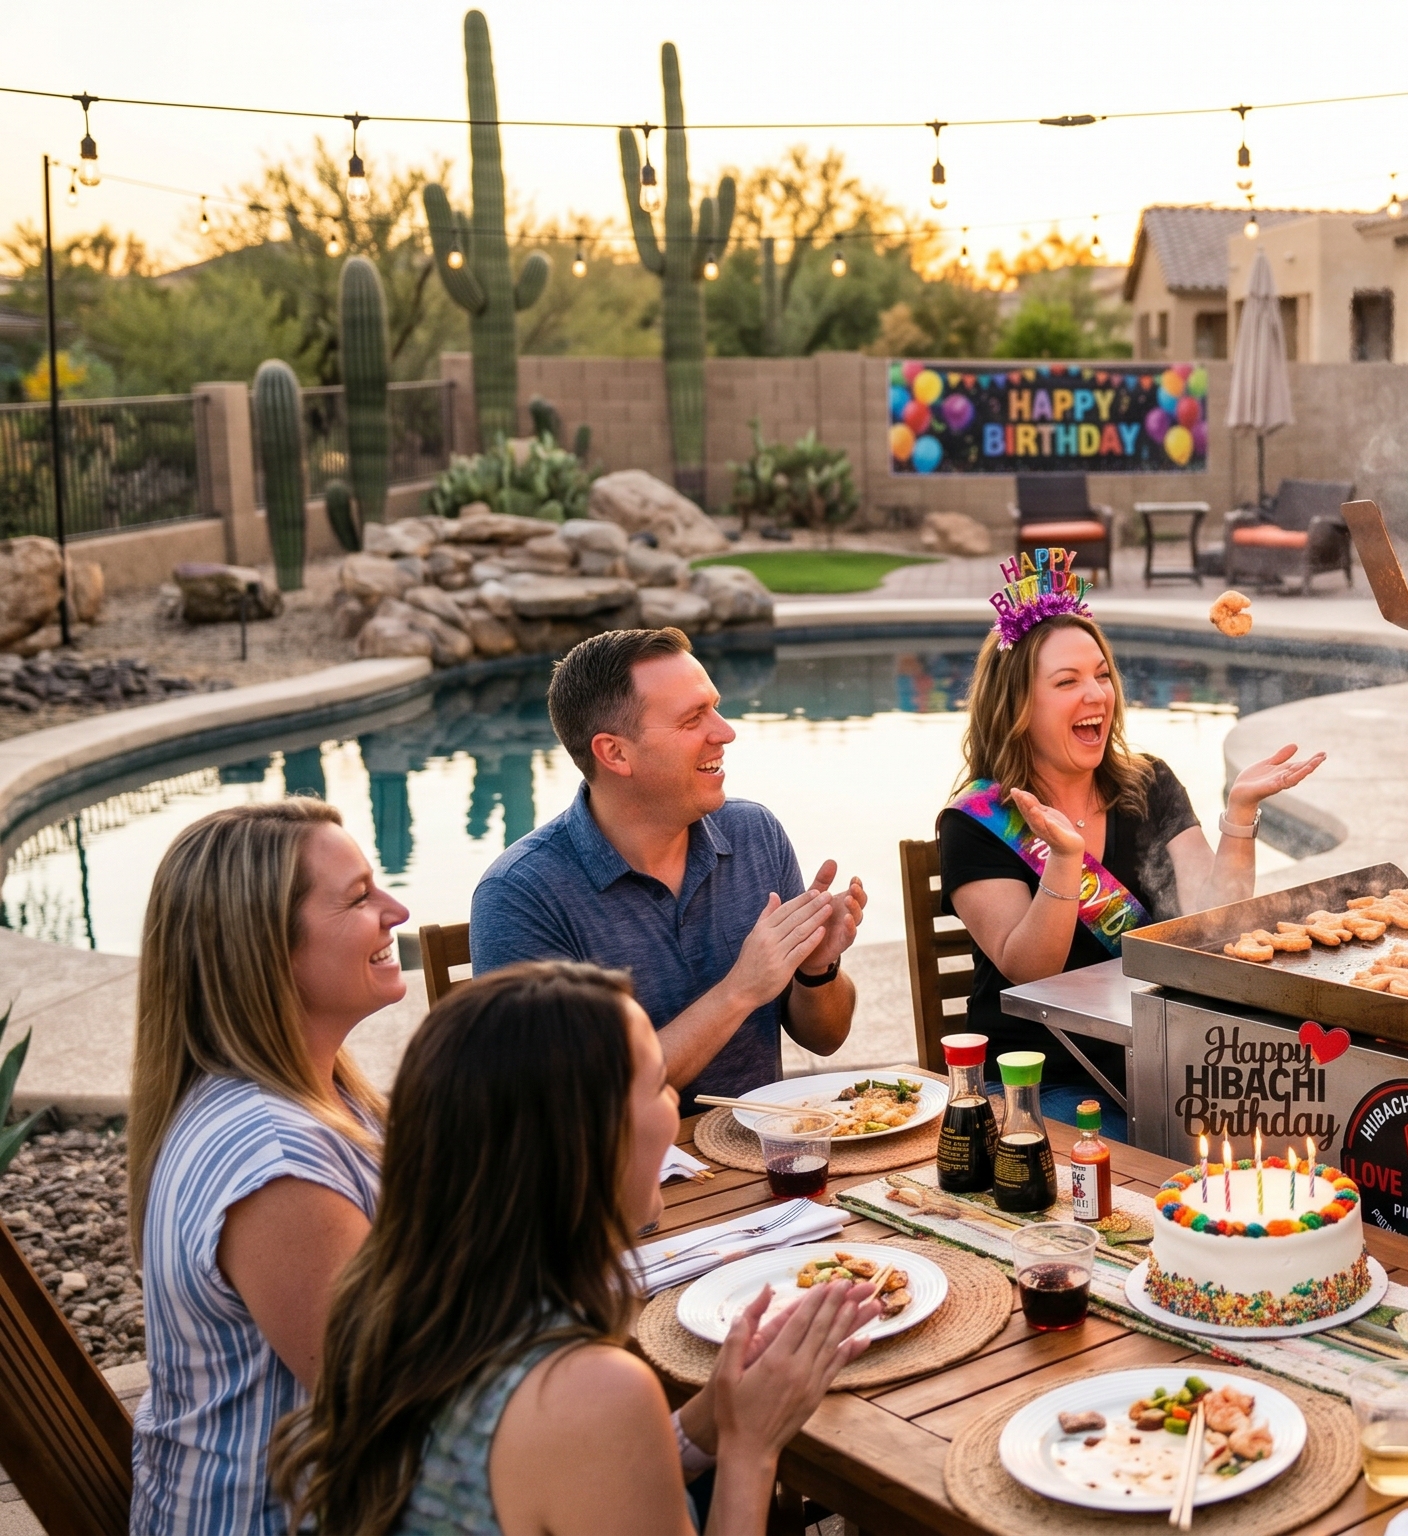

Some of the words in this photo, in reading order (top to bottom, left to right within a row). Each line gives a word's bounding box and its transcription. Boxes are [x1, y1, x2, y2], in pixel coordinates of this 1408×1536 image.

[1008, 389, 1116, 422] HAPPY
[982, 422, 1141, 457] BIRTHDAY
[999, 547, 1077, 583] HAPPY
[1203, 1025, 1315, 1075] Happy
[1185, 1064, 1326, 1103] HIBACHI
[1174, 1093, 1341, 1152] Birthday
[1350, 1157, 1403, 1197] LOVE
